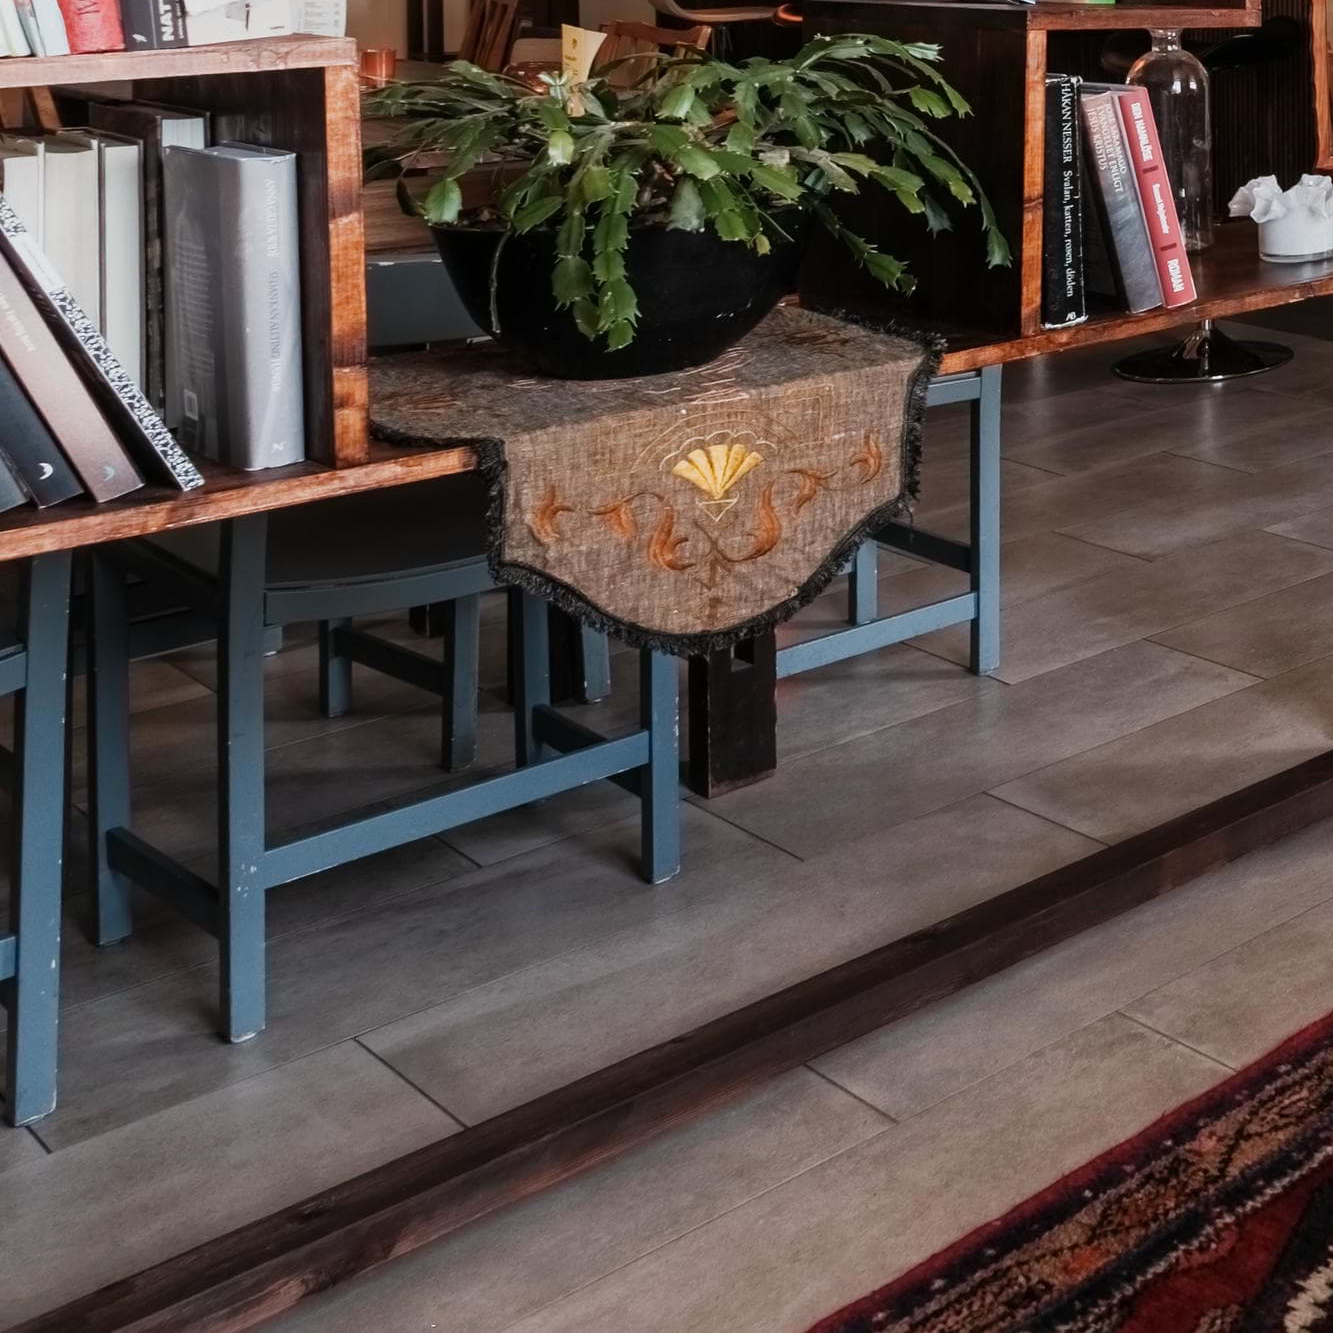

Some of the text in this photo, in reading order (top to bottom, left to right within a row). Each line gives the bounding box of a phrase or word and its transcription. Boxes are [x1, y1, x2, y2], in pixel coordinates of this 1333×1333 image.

[1087, 109, 1107, 171] JESUS KRISTUS
[1097, 105, 1124, 193] EVANGELIET ENLIGT
[1110, 125, 1127, 174] SARAMAGO
[1061, 83, 1076, 297] HÅKAN NESSER Svalan, katten, rosen, döden
[1167, 258, 1185, 293] ROMAN
